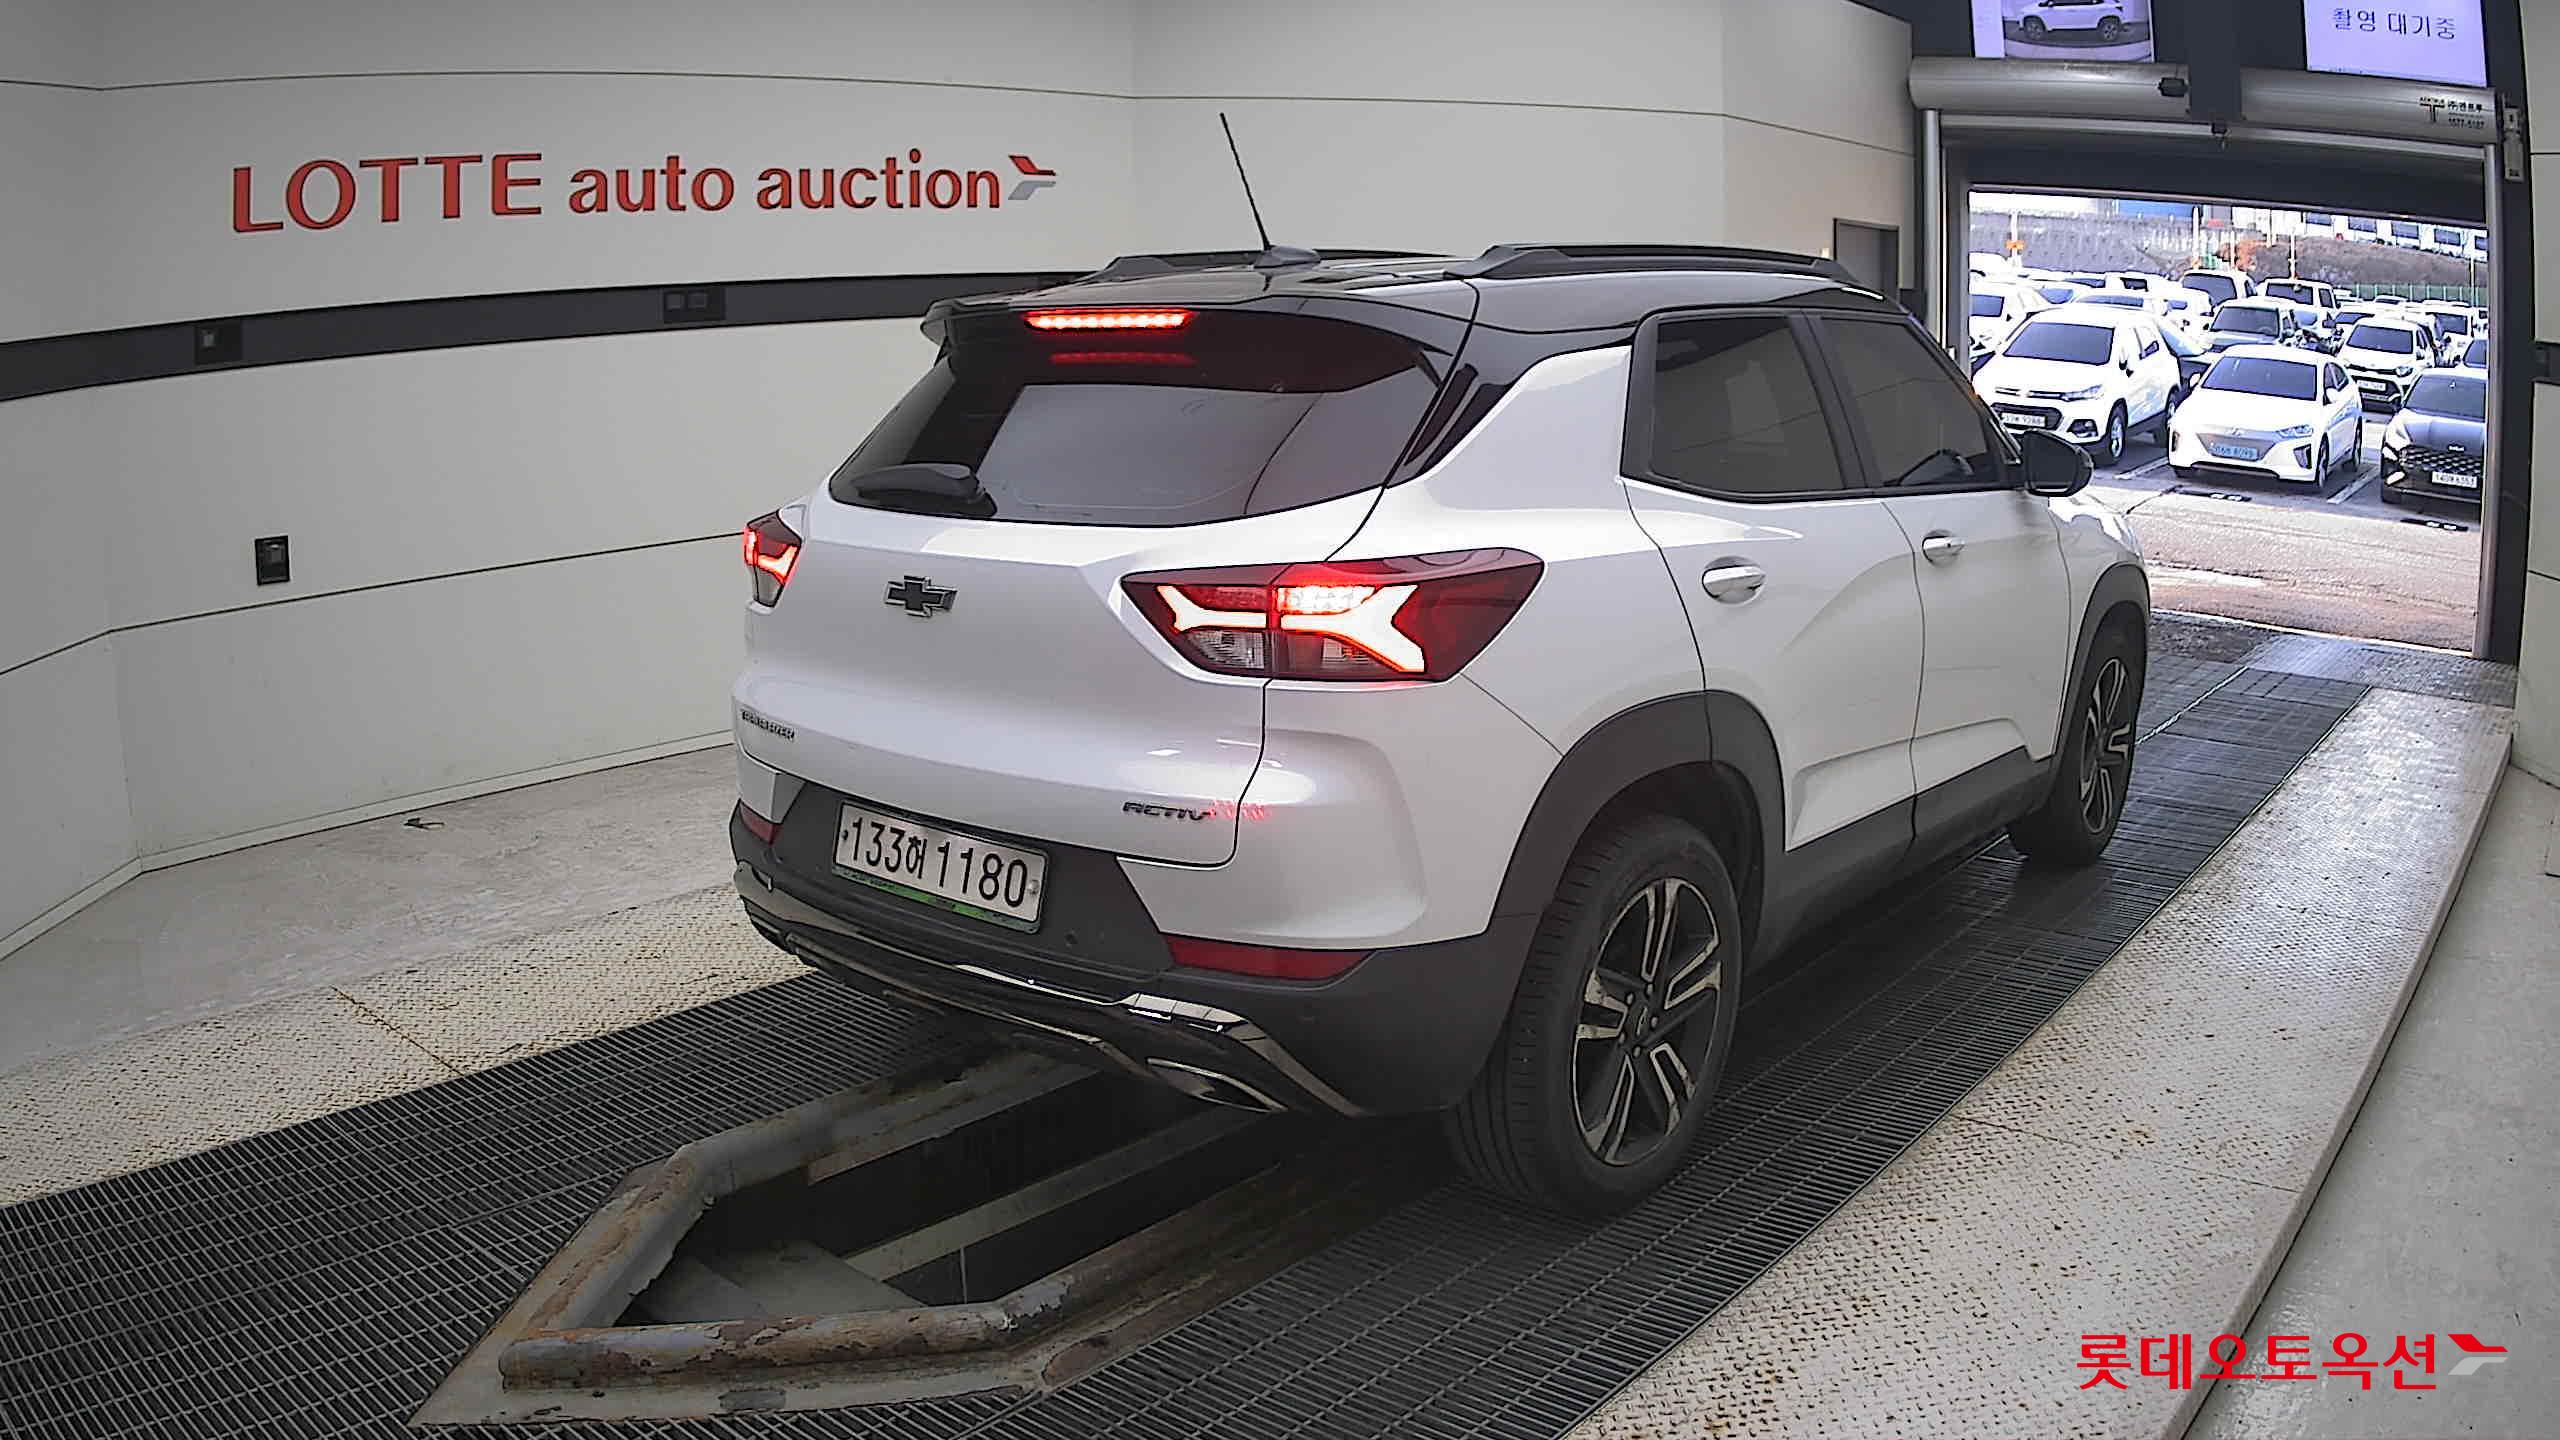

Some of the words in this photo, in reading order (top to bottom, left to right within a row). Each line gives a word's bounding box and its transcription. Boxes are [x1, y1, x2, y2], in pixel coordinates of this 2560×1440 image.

[2332, 7, 2377, 33] 촬영
[2387, 13, 2456, 41] 대기중
[233, 152, 540, 234] LOTTE
[569, 156, 734, 214] auto
[756, 151, 1003, 208] auction
[1122, 801, 1209, 822] ACTIV
[852, 816, 928, 880] 133허
[937, 840, 1029, 908] 1180
